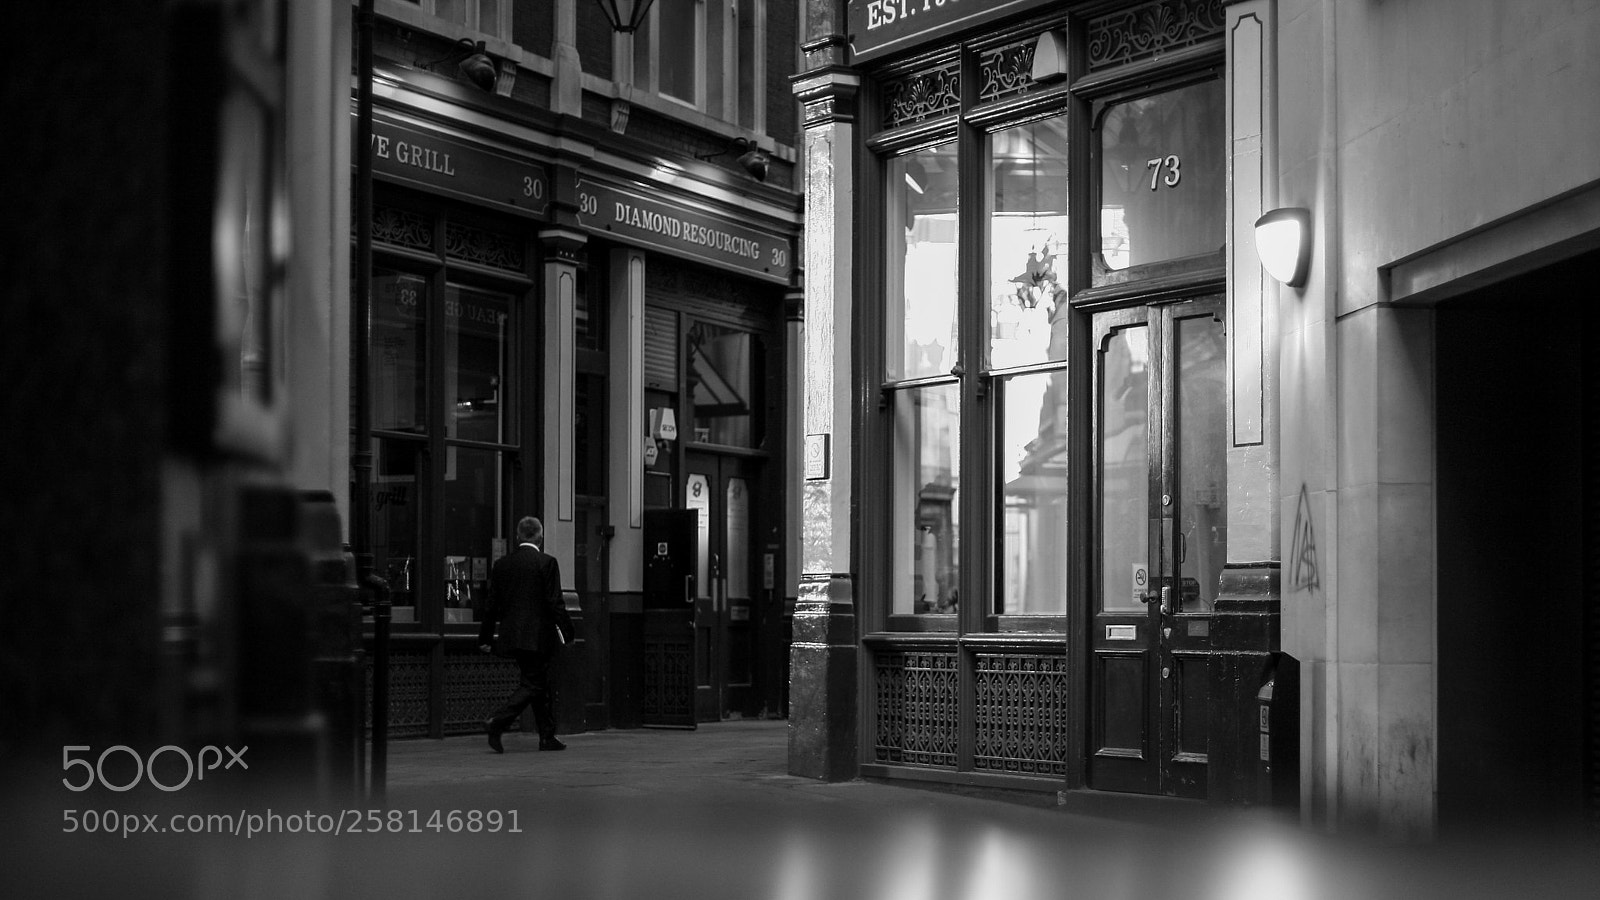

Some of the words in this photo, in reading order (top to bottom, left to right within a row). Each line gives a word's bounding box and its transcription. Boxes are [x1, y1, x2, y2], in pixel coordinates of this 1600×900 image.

[396, 141, 455, 177] GRILL
[523, 175, 543, 200] 30
[1147, 154, 1181, 191] 73
[580, 192, 598, 216] 30
[615, 202, 681, 239] DIAMOND
[683, 221, 760, 260] RESOURCING
[771, 247, 786, 268] 30
